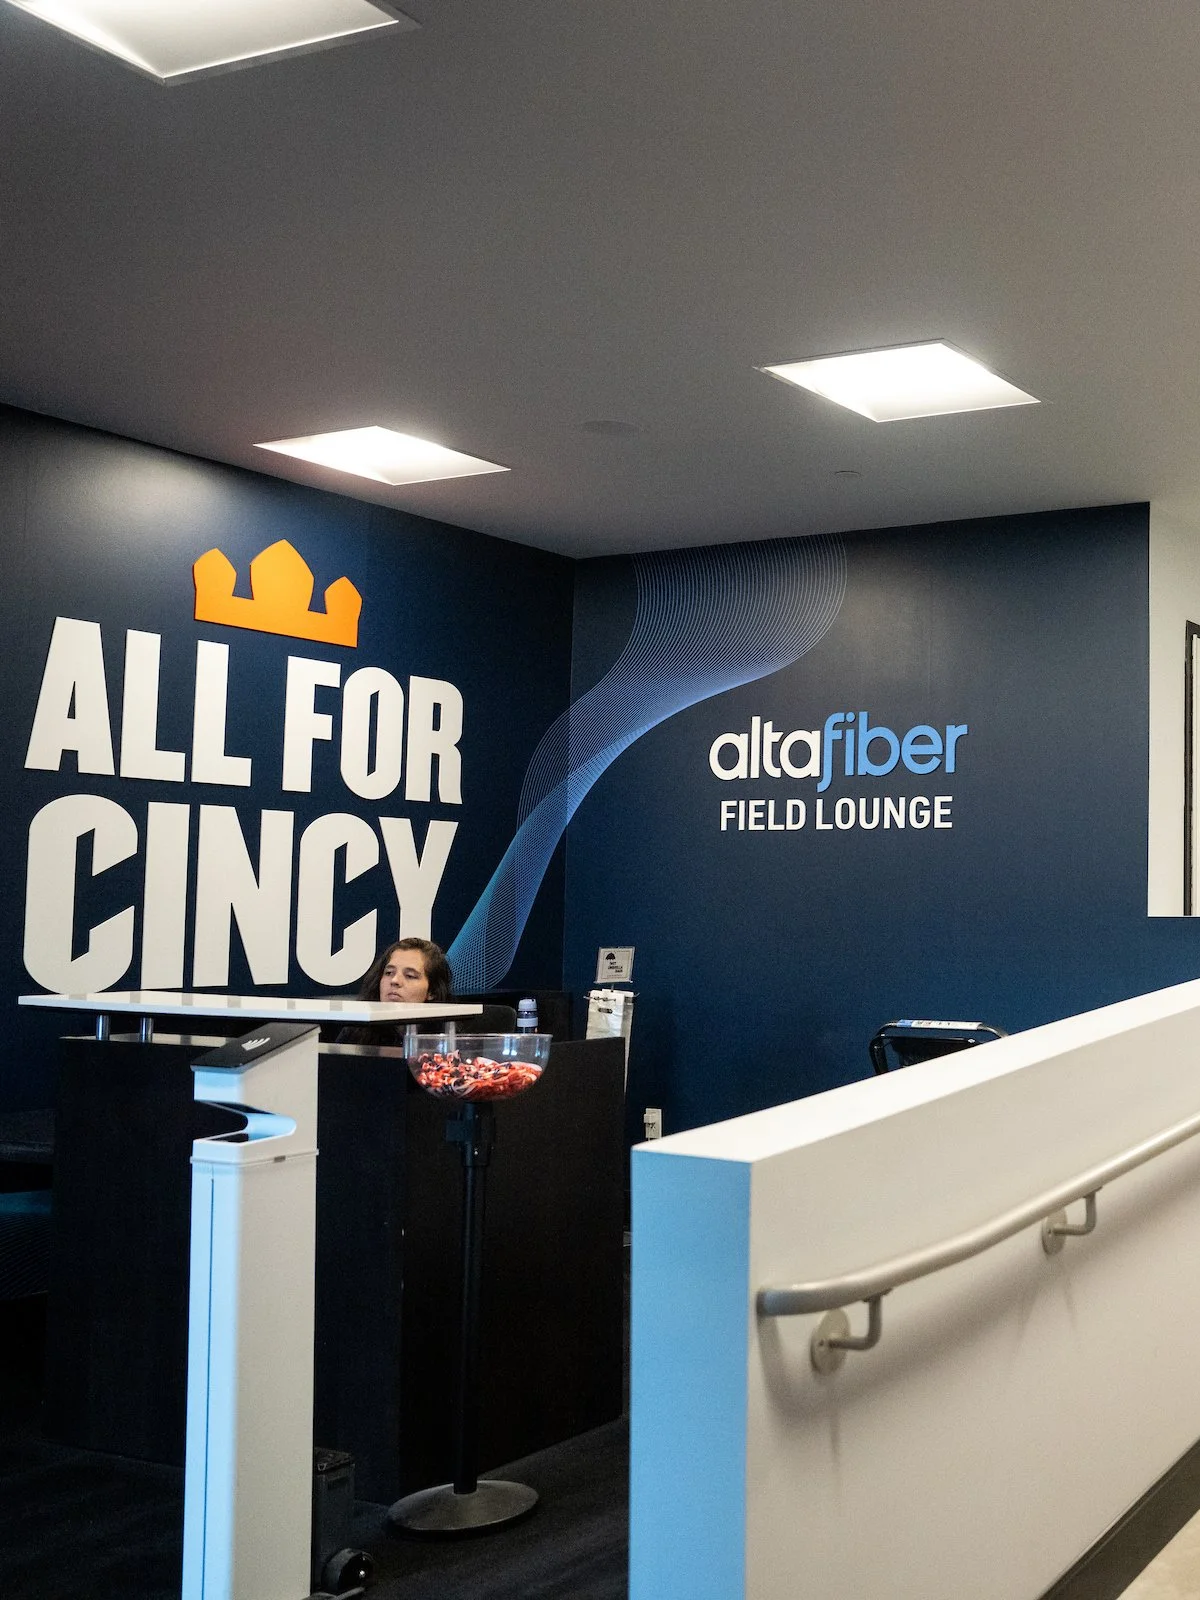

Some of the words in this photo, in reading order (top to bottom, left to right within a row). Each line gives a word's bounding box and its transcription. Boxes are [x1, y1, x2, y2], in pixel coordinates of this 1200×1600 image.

[24, 616, 252, 787] ALL
[282, 655, 463, 804] FOR
[709, 711, 968, 793] altafiber
[721, 799, 806, 831] FIELD
[816, 796, 952, 830] LOUNGE
[23, 794, 459, 994] CINCY
